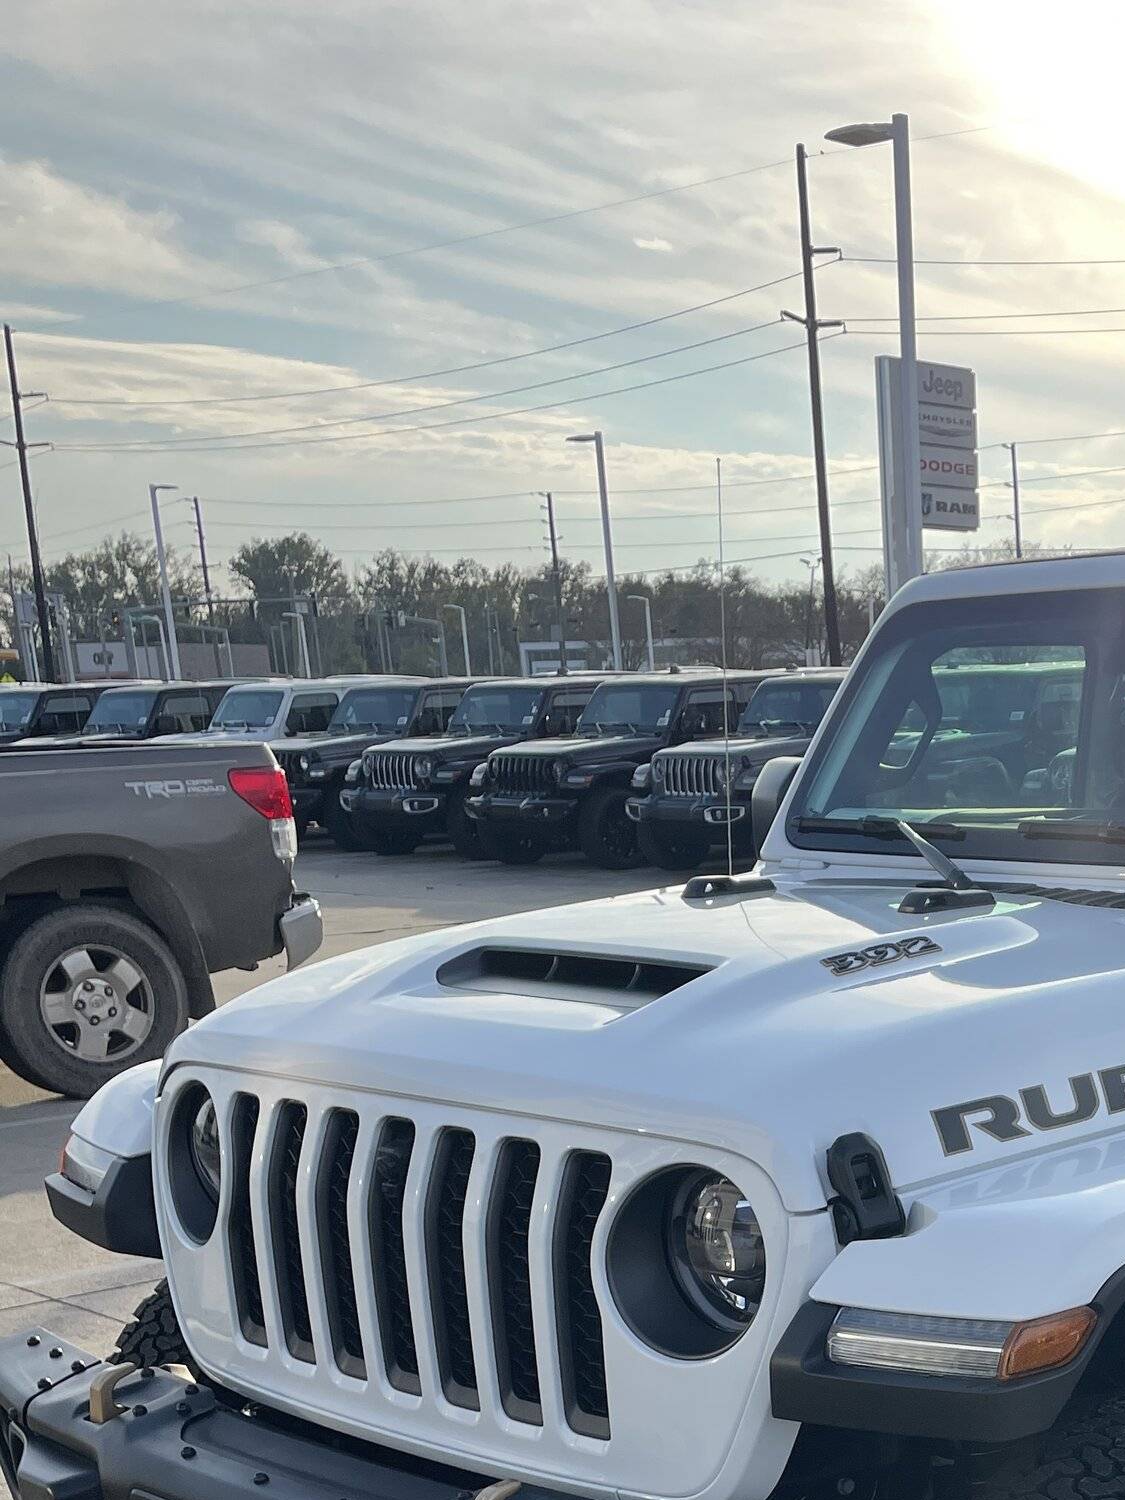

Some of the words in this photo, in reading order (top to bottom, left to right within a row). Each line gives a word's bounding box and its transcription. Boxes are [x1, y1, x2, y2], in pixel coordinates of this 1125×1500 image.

[922, 369, 963, 401] Jeep
[935, 500, 977, 515] RAM
[124, 780, 187, 799] TRD
[819, 935, 943, 977] 392
